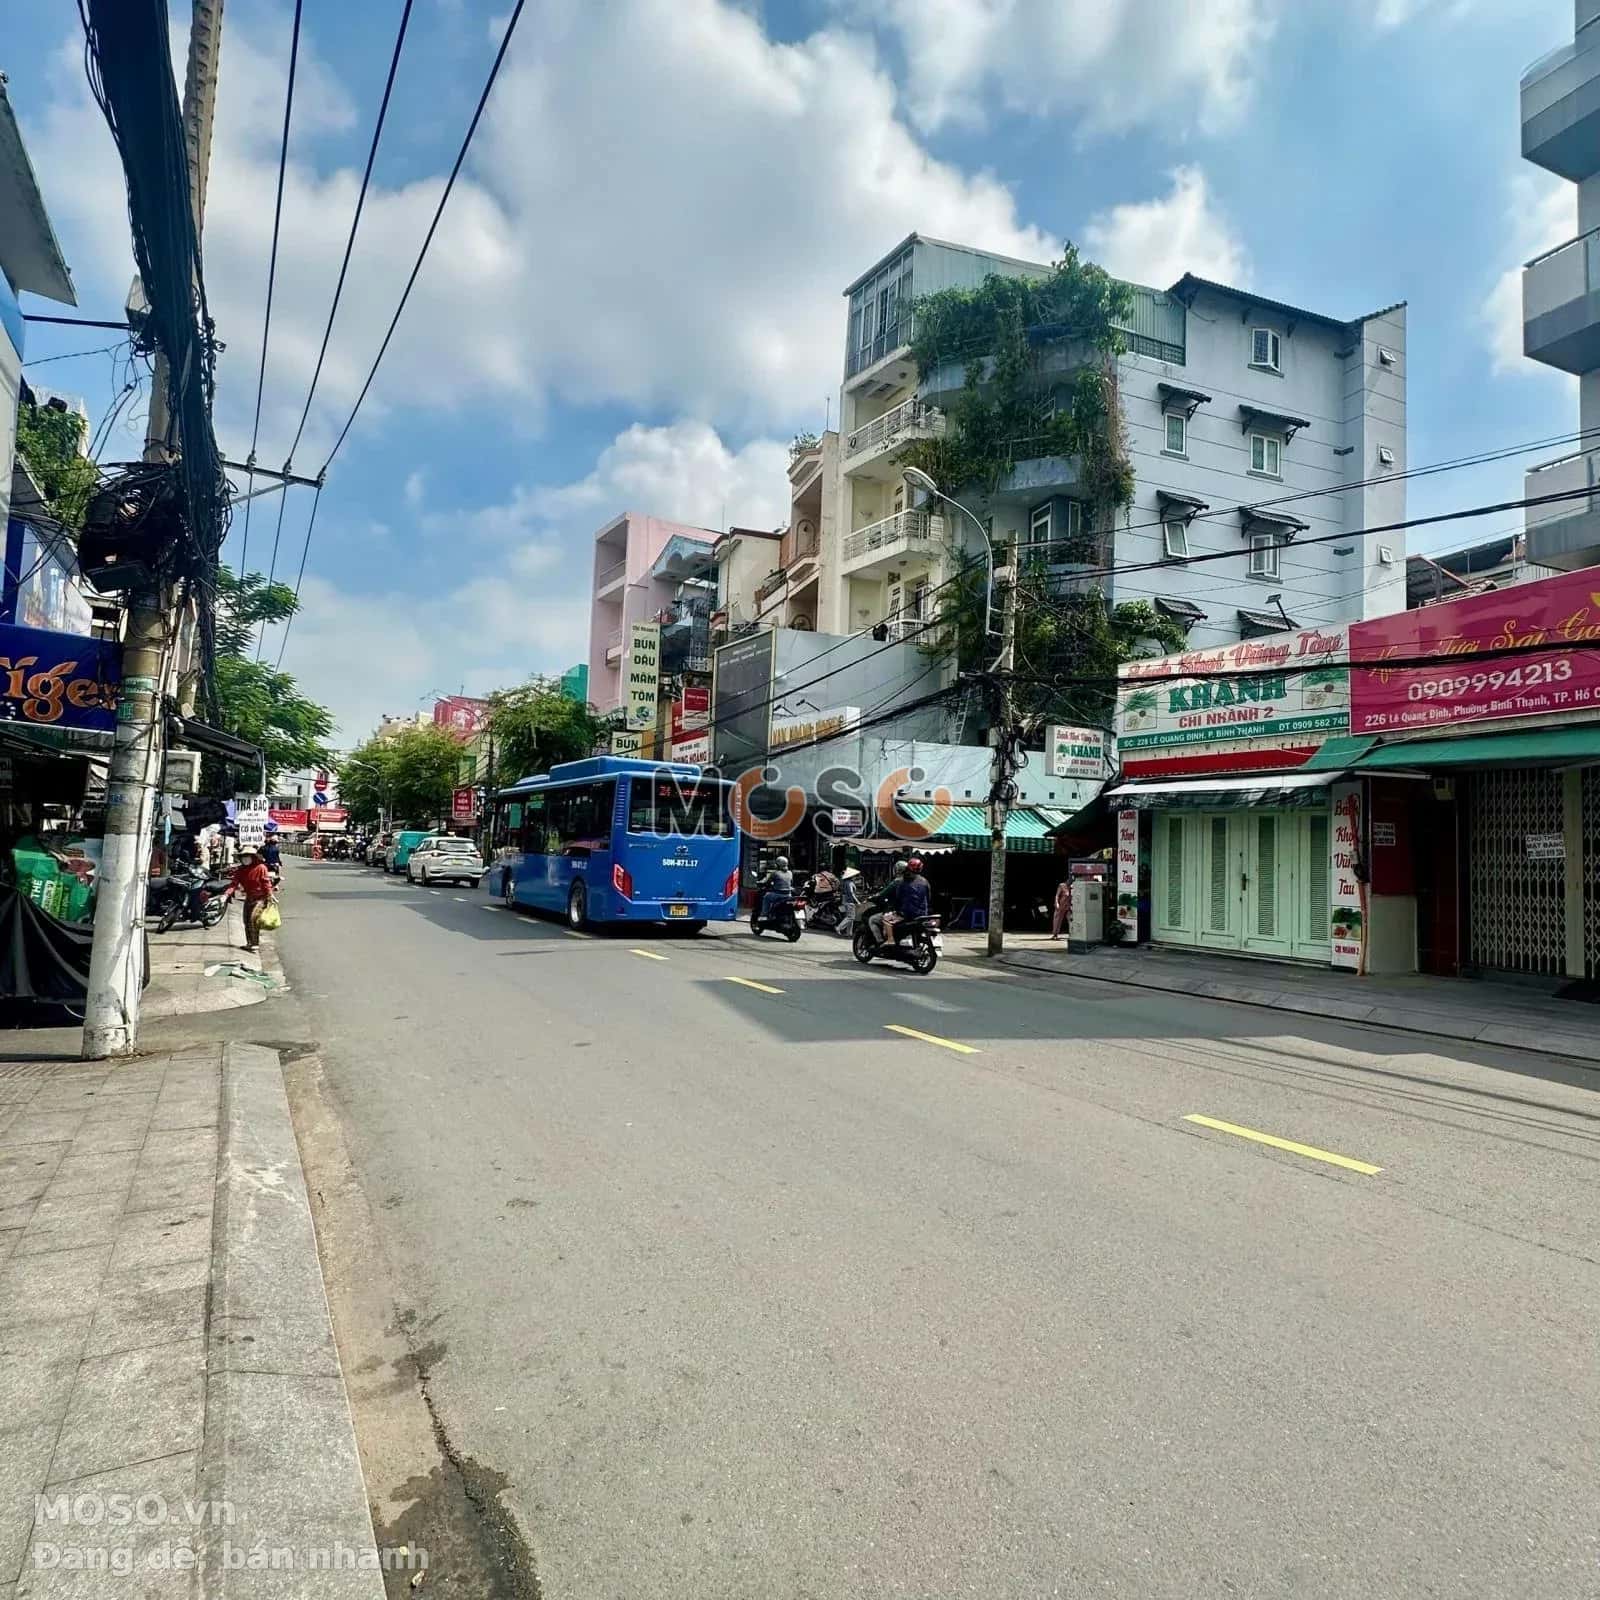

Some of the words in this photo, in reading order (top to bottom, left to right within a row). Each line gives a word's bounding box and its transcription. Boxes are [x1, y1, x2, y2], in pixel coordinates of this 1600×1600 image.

[1408, 659, 1572, 701] 0909994213
[1179, 714, 1202, 728] CHI
[1264, 706, 1274, 719] 2
[1364, 713, 1386, 727] 226
[1553, 691, 1572, 703] TP.
[1292, 720, 1313, 730] 0909
